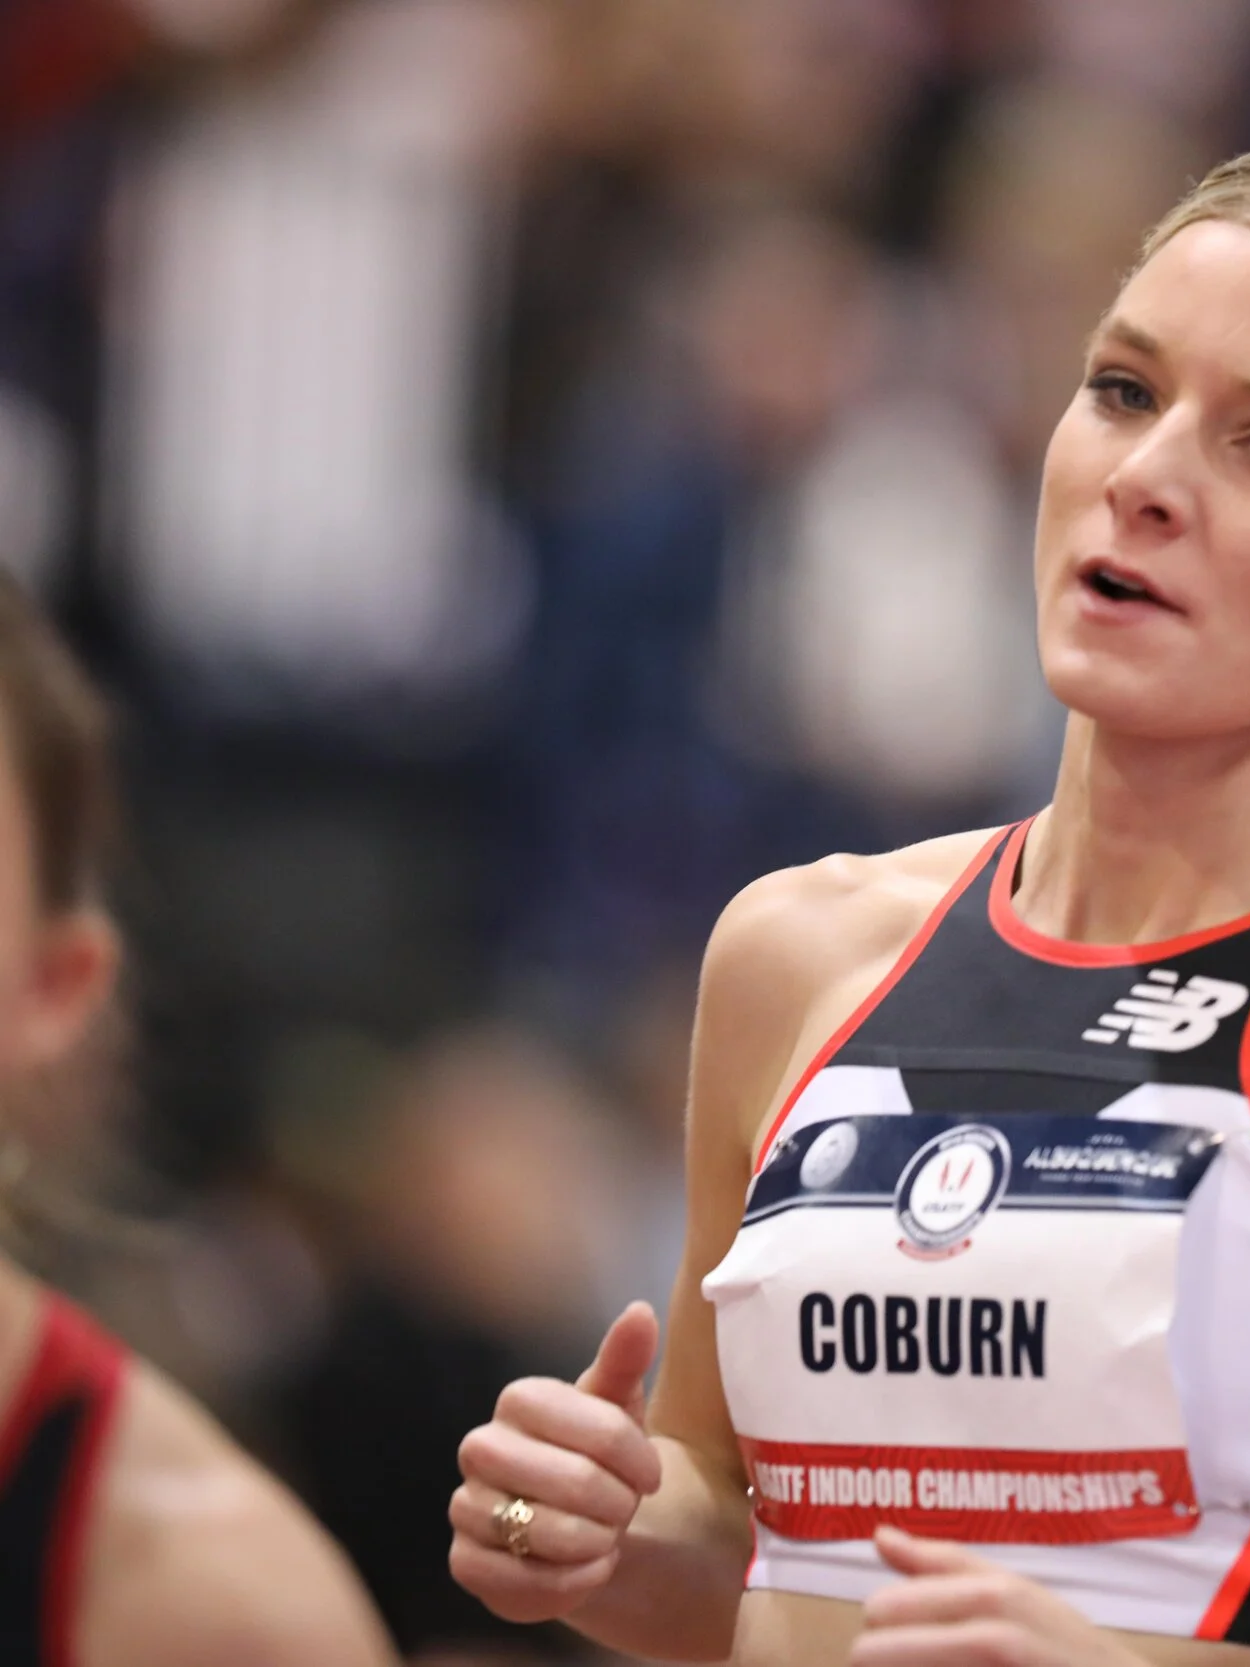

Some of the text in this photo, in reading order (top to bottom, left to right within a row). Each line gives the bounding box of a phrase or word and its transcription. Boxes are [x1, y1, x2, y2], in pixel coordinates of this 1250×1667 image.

[799, 1291, 1046, 1378] COBURN
[810, 1466, 913, 1507] INDOOR
[917, 1467, 1164, 1512] CHAMPIONSHIPS
